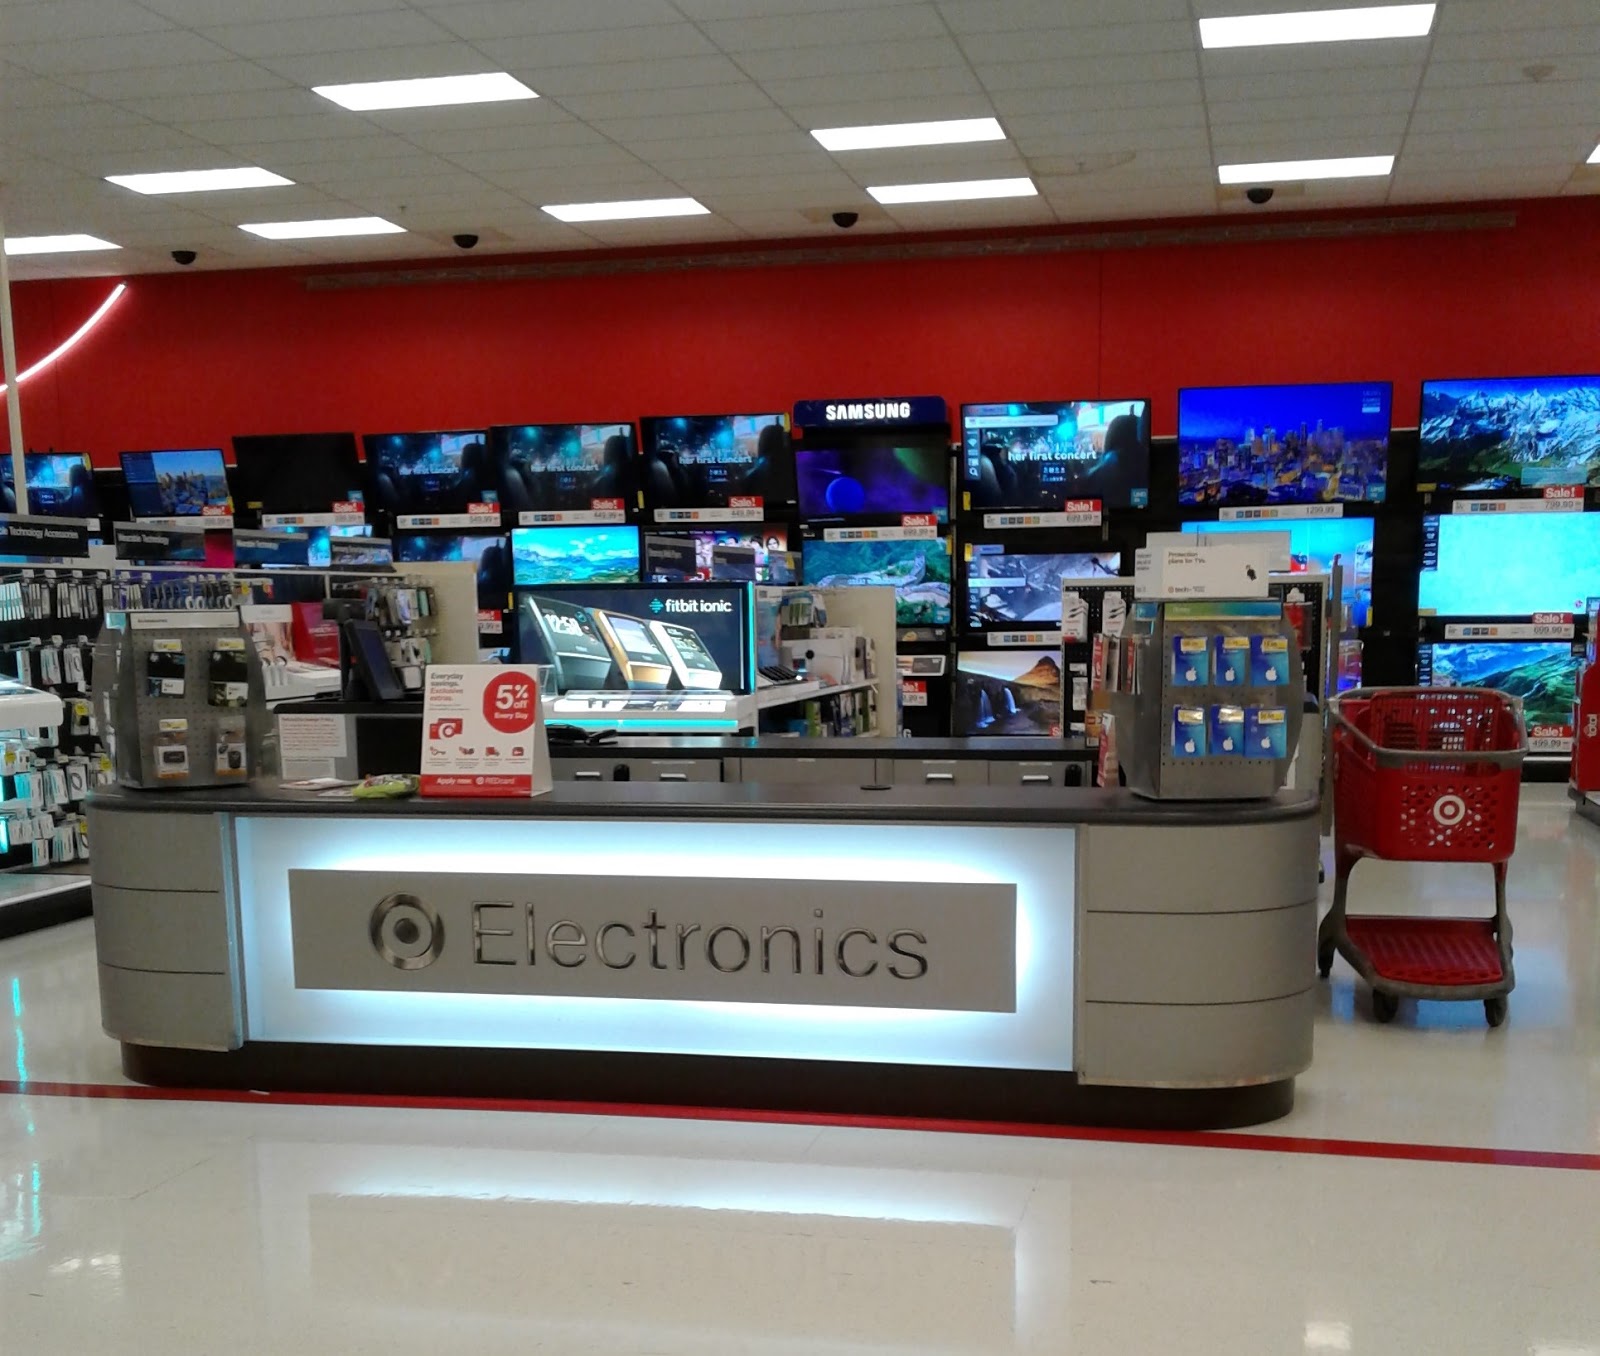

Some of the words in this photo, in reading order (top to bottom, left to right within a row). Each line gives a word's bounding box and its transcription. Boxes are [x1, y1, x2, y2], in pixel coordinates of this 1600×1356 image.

[825, 402, 911, 420] SAMSUNG
[679, 456, 695, 464] her
[1008, 451, 1026, 461] her
[1029, 451, 1051, 461] first
[1054, 450, 1097, 460] concert
[1545, 487, 1576, 499] Sale!
[334, 502, 357, 512] Sale!
[592, 500, 618, 509] Sale!
[731, 498, 756, 507] Sale!
[1066, 501, 1094, 512] Sale!
[203, 506, 226, 515] Sale!
[468, 503, 494, 513] Sale!
[903, 515, 928, 526] Sale!
[9, 526, 43, 538] Technology
[665, 599, 698, 612] fitbit
[699, 600, 732, 612] ionic
[1534, 614, 1564, 624] Sale!
[430, 673, 463, 681] Everyday
[514, 700, 529, 709] off
[494, 711, 513, 720] Every
[515, 712, 529, 720] Day
[1533, 727, 1564, 737] Sale!
[436, 777, 456, 785] Apply
[471, 900, 930, 981] Electronics
